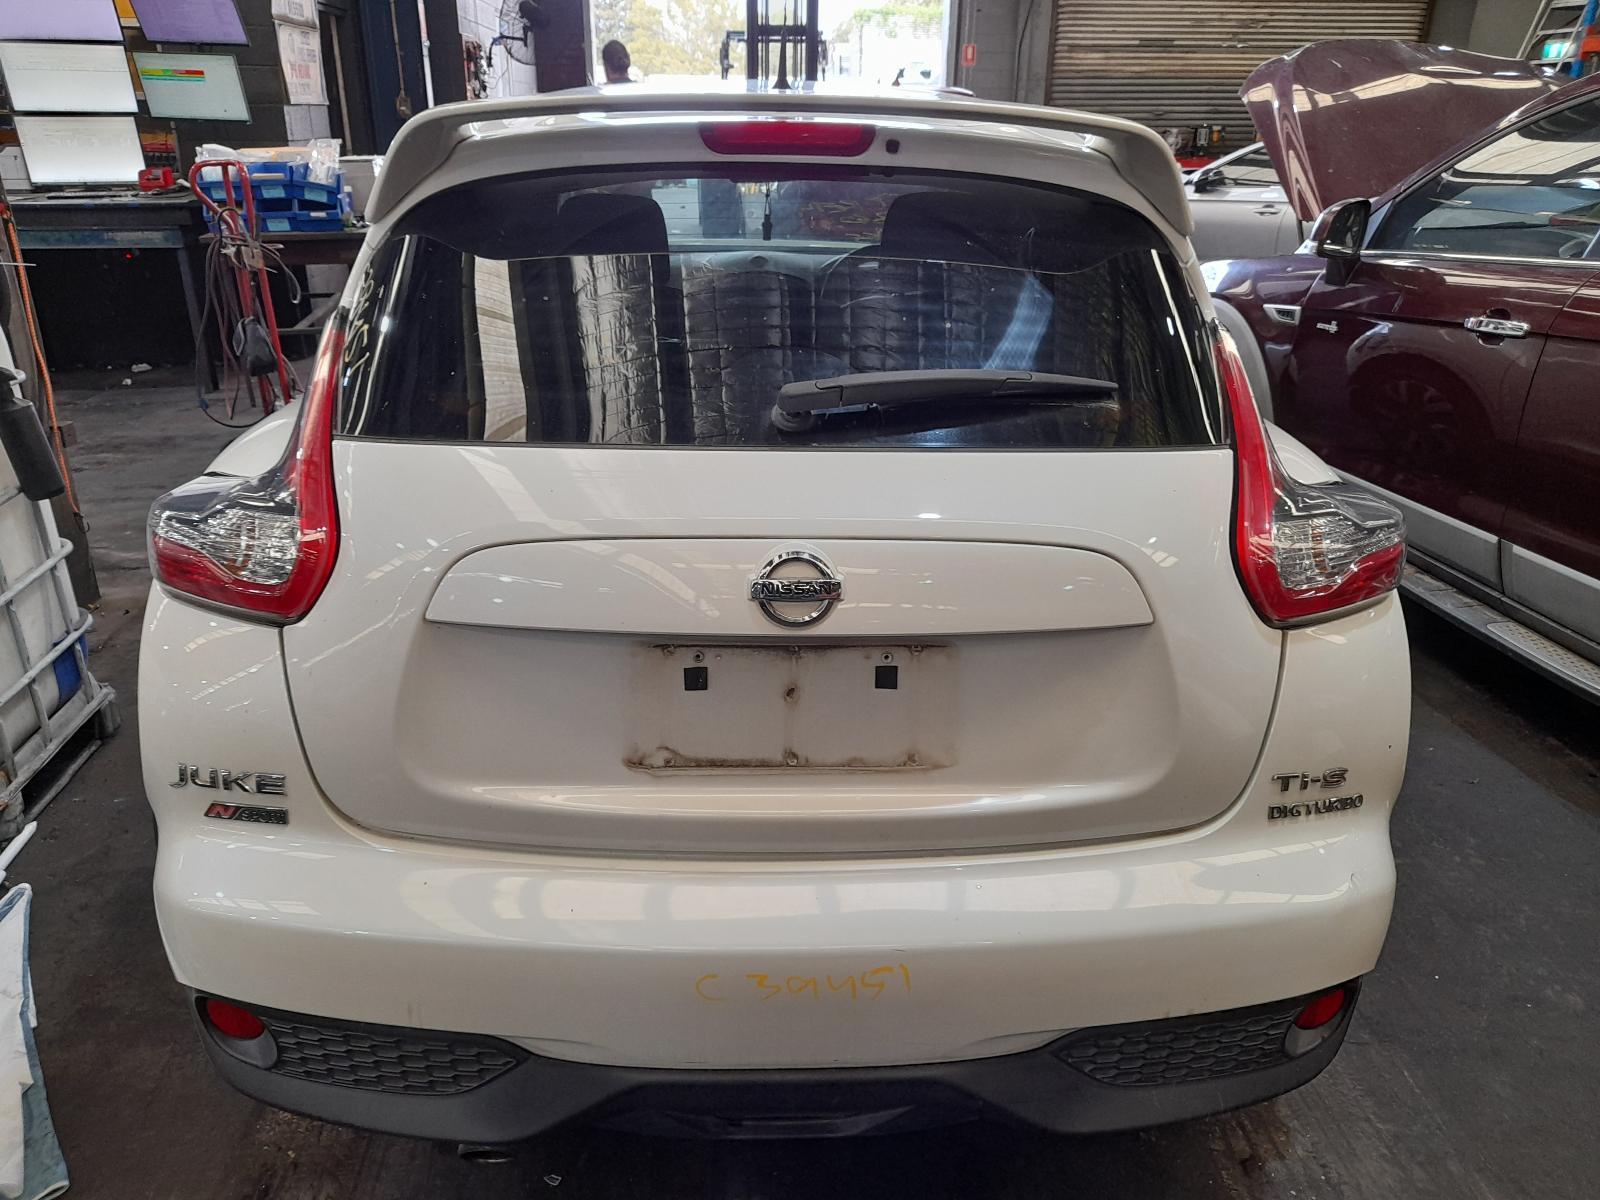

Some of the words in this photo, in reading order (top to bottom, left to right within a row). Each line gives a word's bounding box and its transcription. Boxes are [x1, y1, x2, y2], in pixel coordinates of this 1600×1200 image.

[760, 582, 832, 595] NISSAN
[169, 762, 288, 796] JUKE
[745, 963, 911, 1000] 39451
